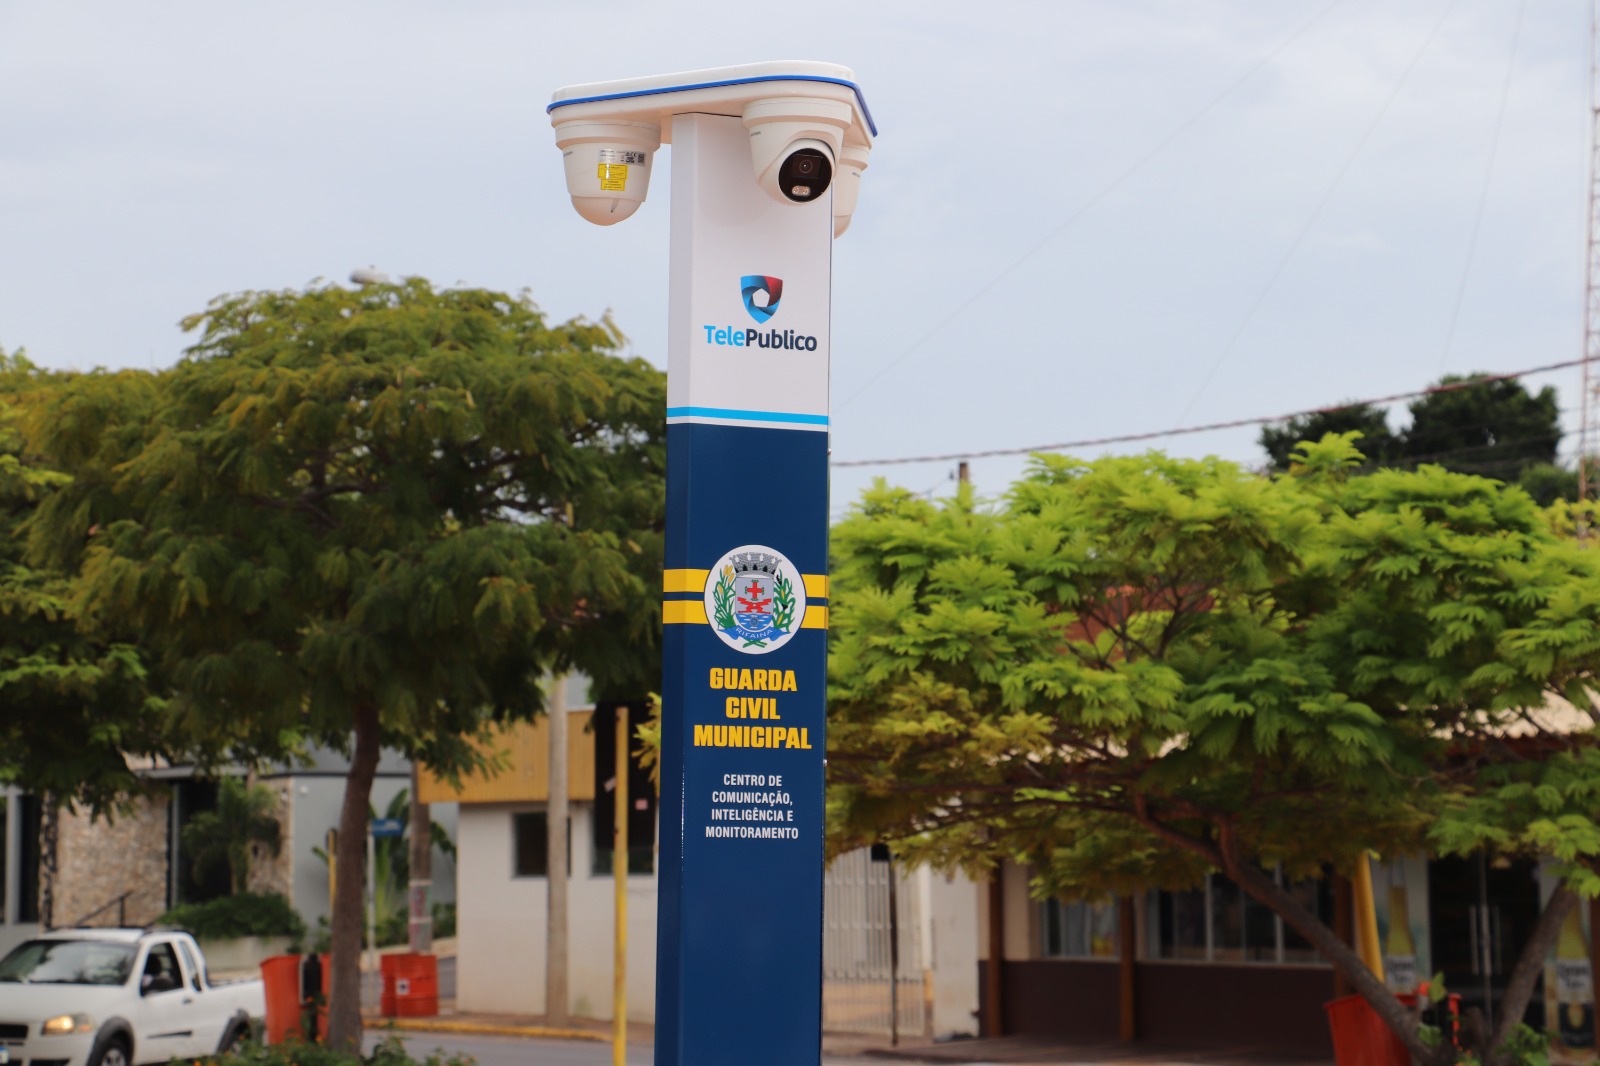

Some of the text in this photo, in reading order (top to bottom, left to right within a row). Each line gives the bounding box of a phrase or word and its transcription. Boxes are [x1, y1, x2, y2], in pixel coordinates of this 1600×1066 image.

[704, 325, 817, 351] TelePublico
[735, 627, 774, 639] RIFAINA
[709, 667, 797, 692] GUARDA
[725, 696, 781, 720] CIVIL
[693, 724, 812, 749] MUNICIPAL
[723, 773, 783, 787] CENTRO DE
[712, 790, 793, 807] COMUNICAÇÃO,
[711, 807, 794, 822] INTELIGÊNCIA E
[705, 826, 799, 840] MONITORAMENTO
